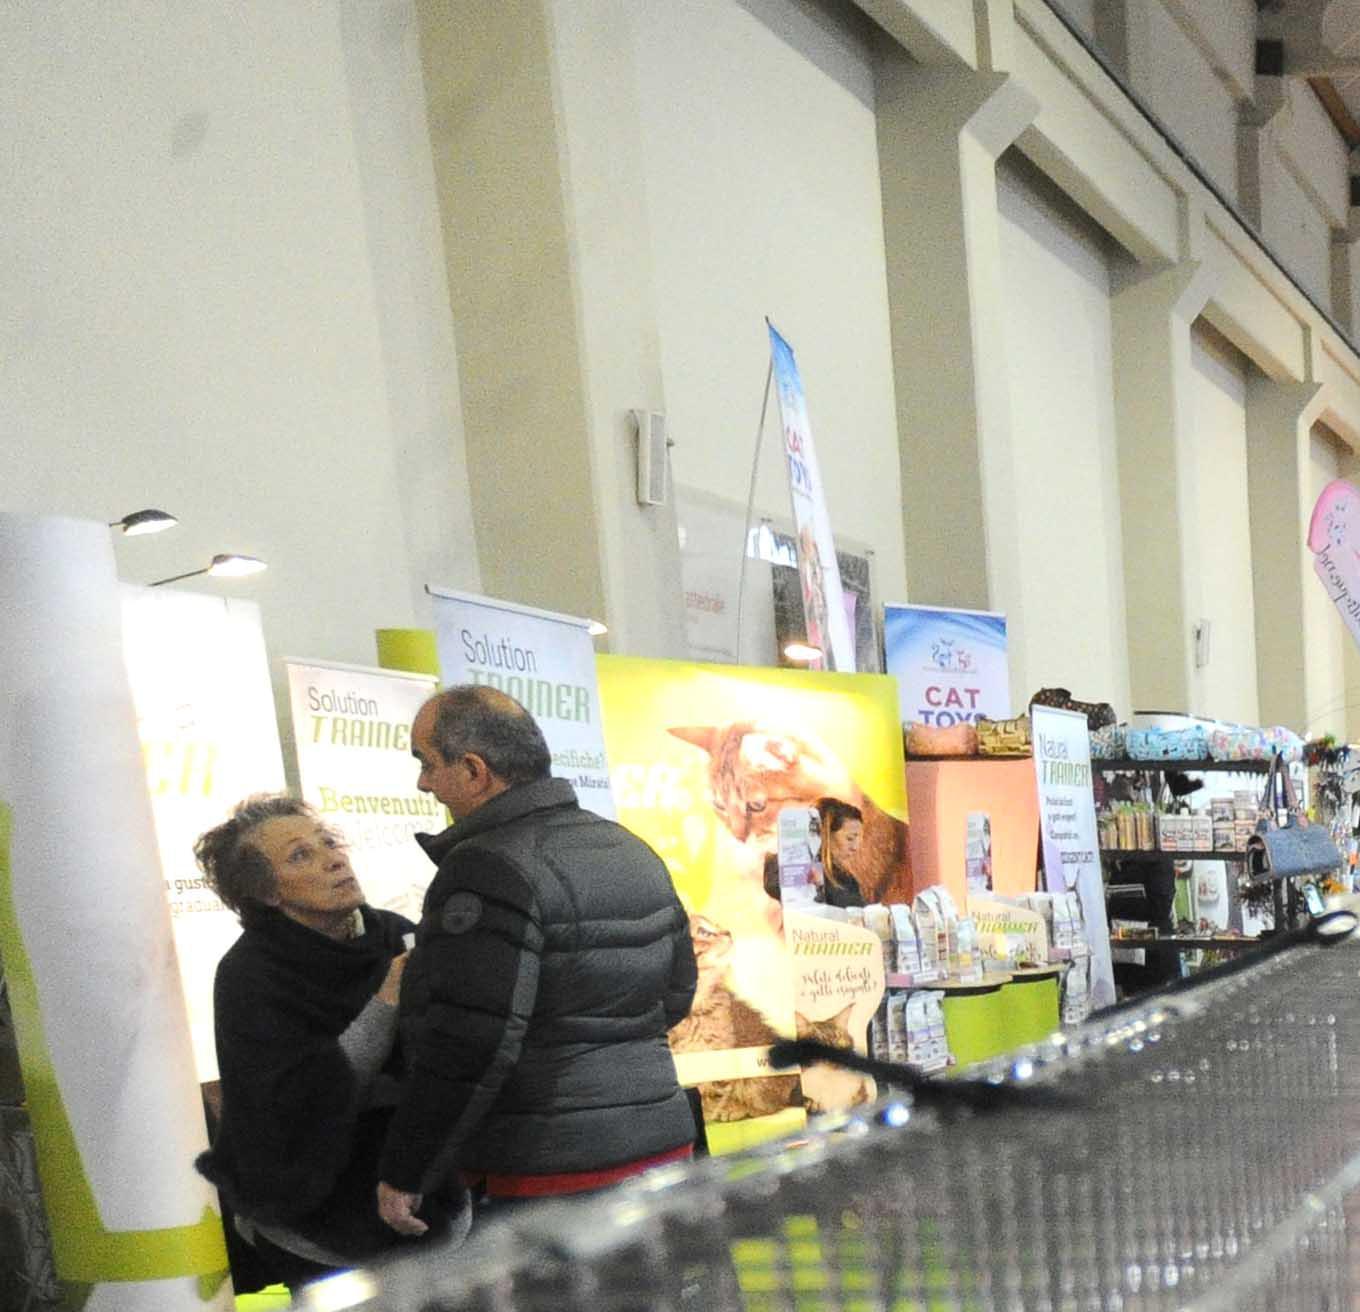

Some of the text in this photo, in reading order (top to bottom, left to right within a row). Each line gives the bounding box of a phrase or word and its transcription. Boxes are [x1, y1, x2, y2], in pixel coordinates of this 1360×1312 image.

[460, 629, 537, 673] Solution
[307, 686, 379, 717] Solution
[925, 686, 981, 709] CAT
[310, 714, 409, 751] TRAINE
[792, 927, 840, 942] Natural
